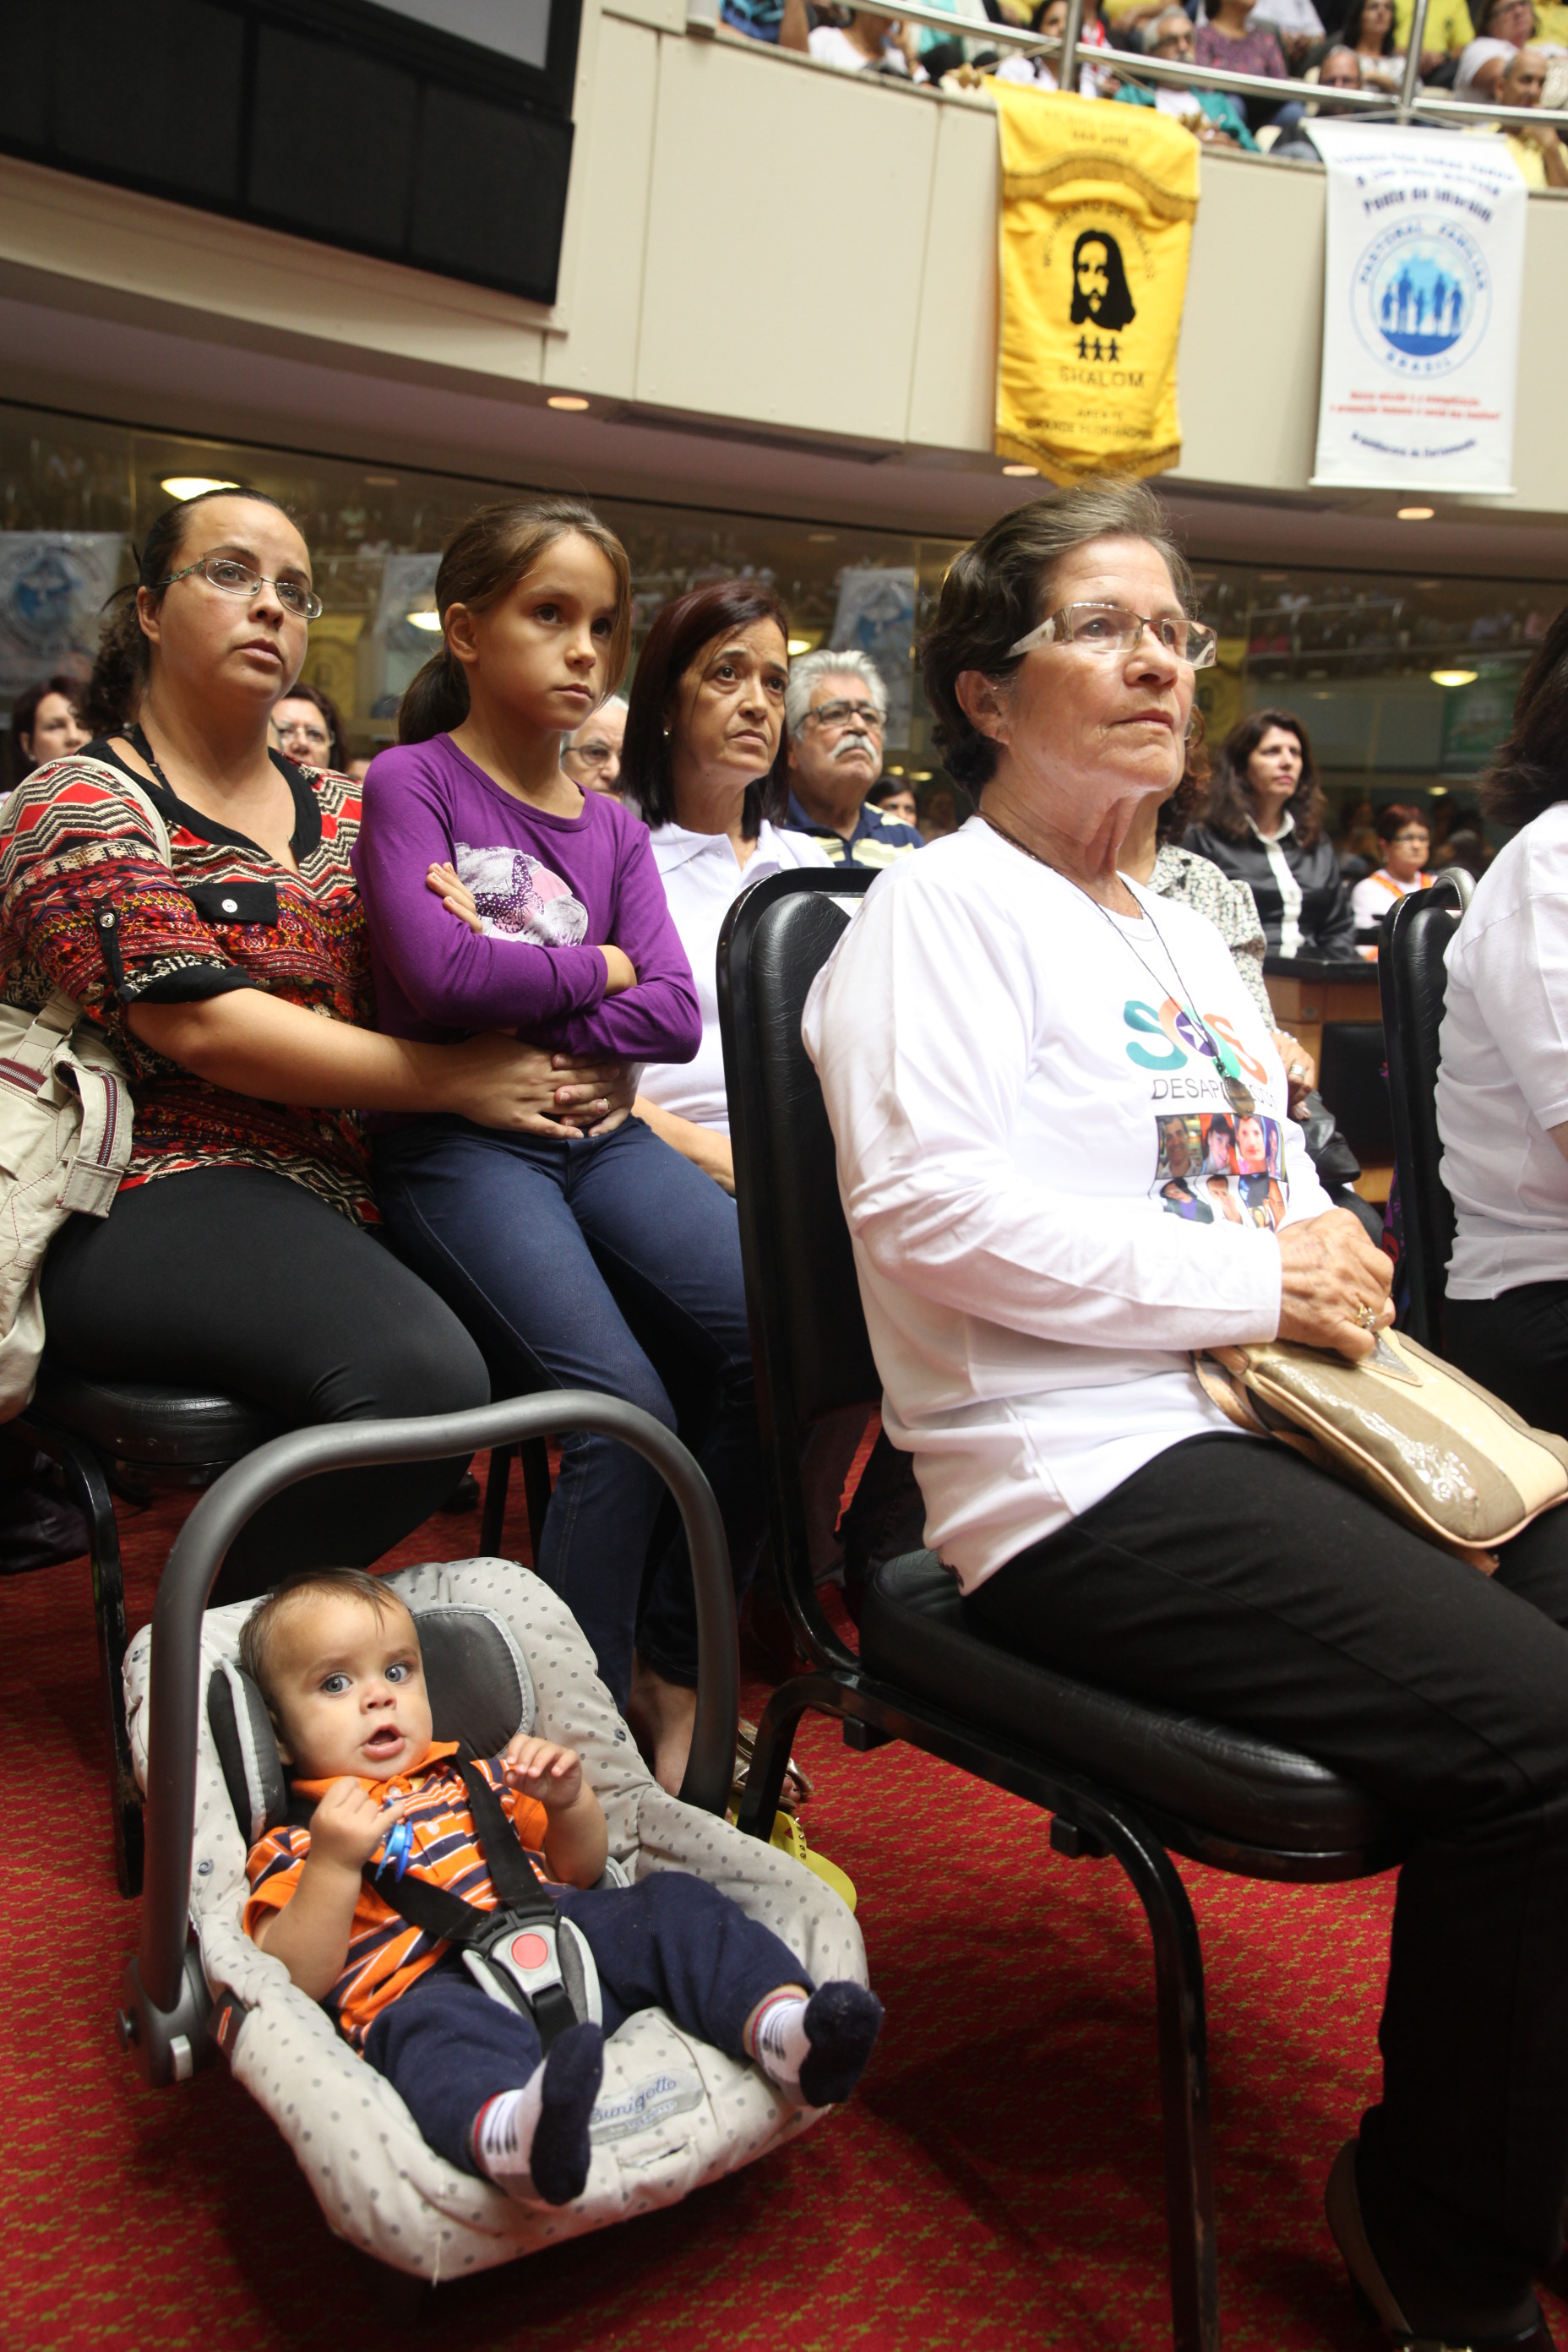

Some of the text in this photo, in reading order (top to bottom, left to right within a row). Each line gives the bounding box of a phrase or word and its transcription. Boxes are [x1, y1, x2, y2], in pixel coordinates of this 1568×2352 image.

[1360, 221, 1485, 290] PASTORAL FAMILIAR
[1059, 365, 1145, 389] SHALOM
[1386, 351, 1451, 373] BRASIL
[1124, 997, 1268, 1085] SOS
[590, 2076, 677, 2124] Burigotto
